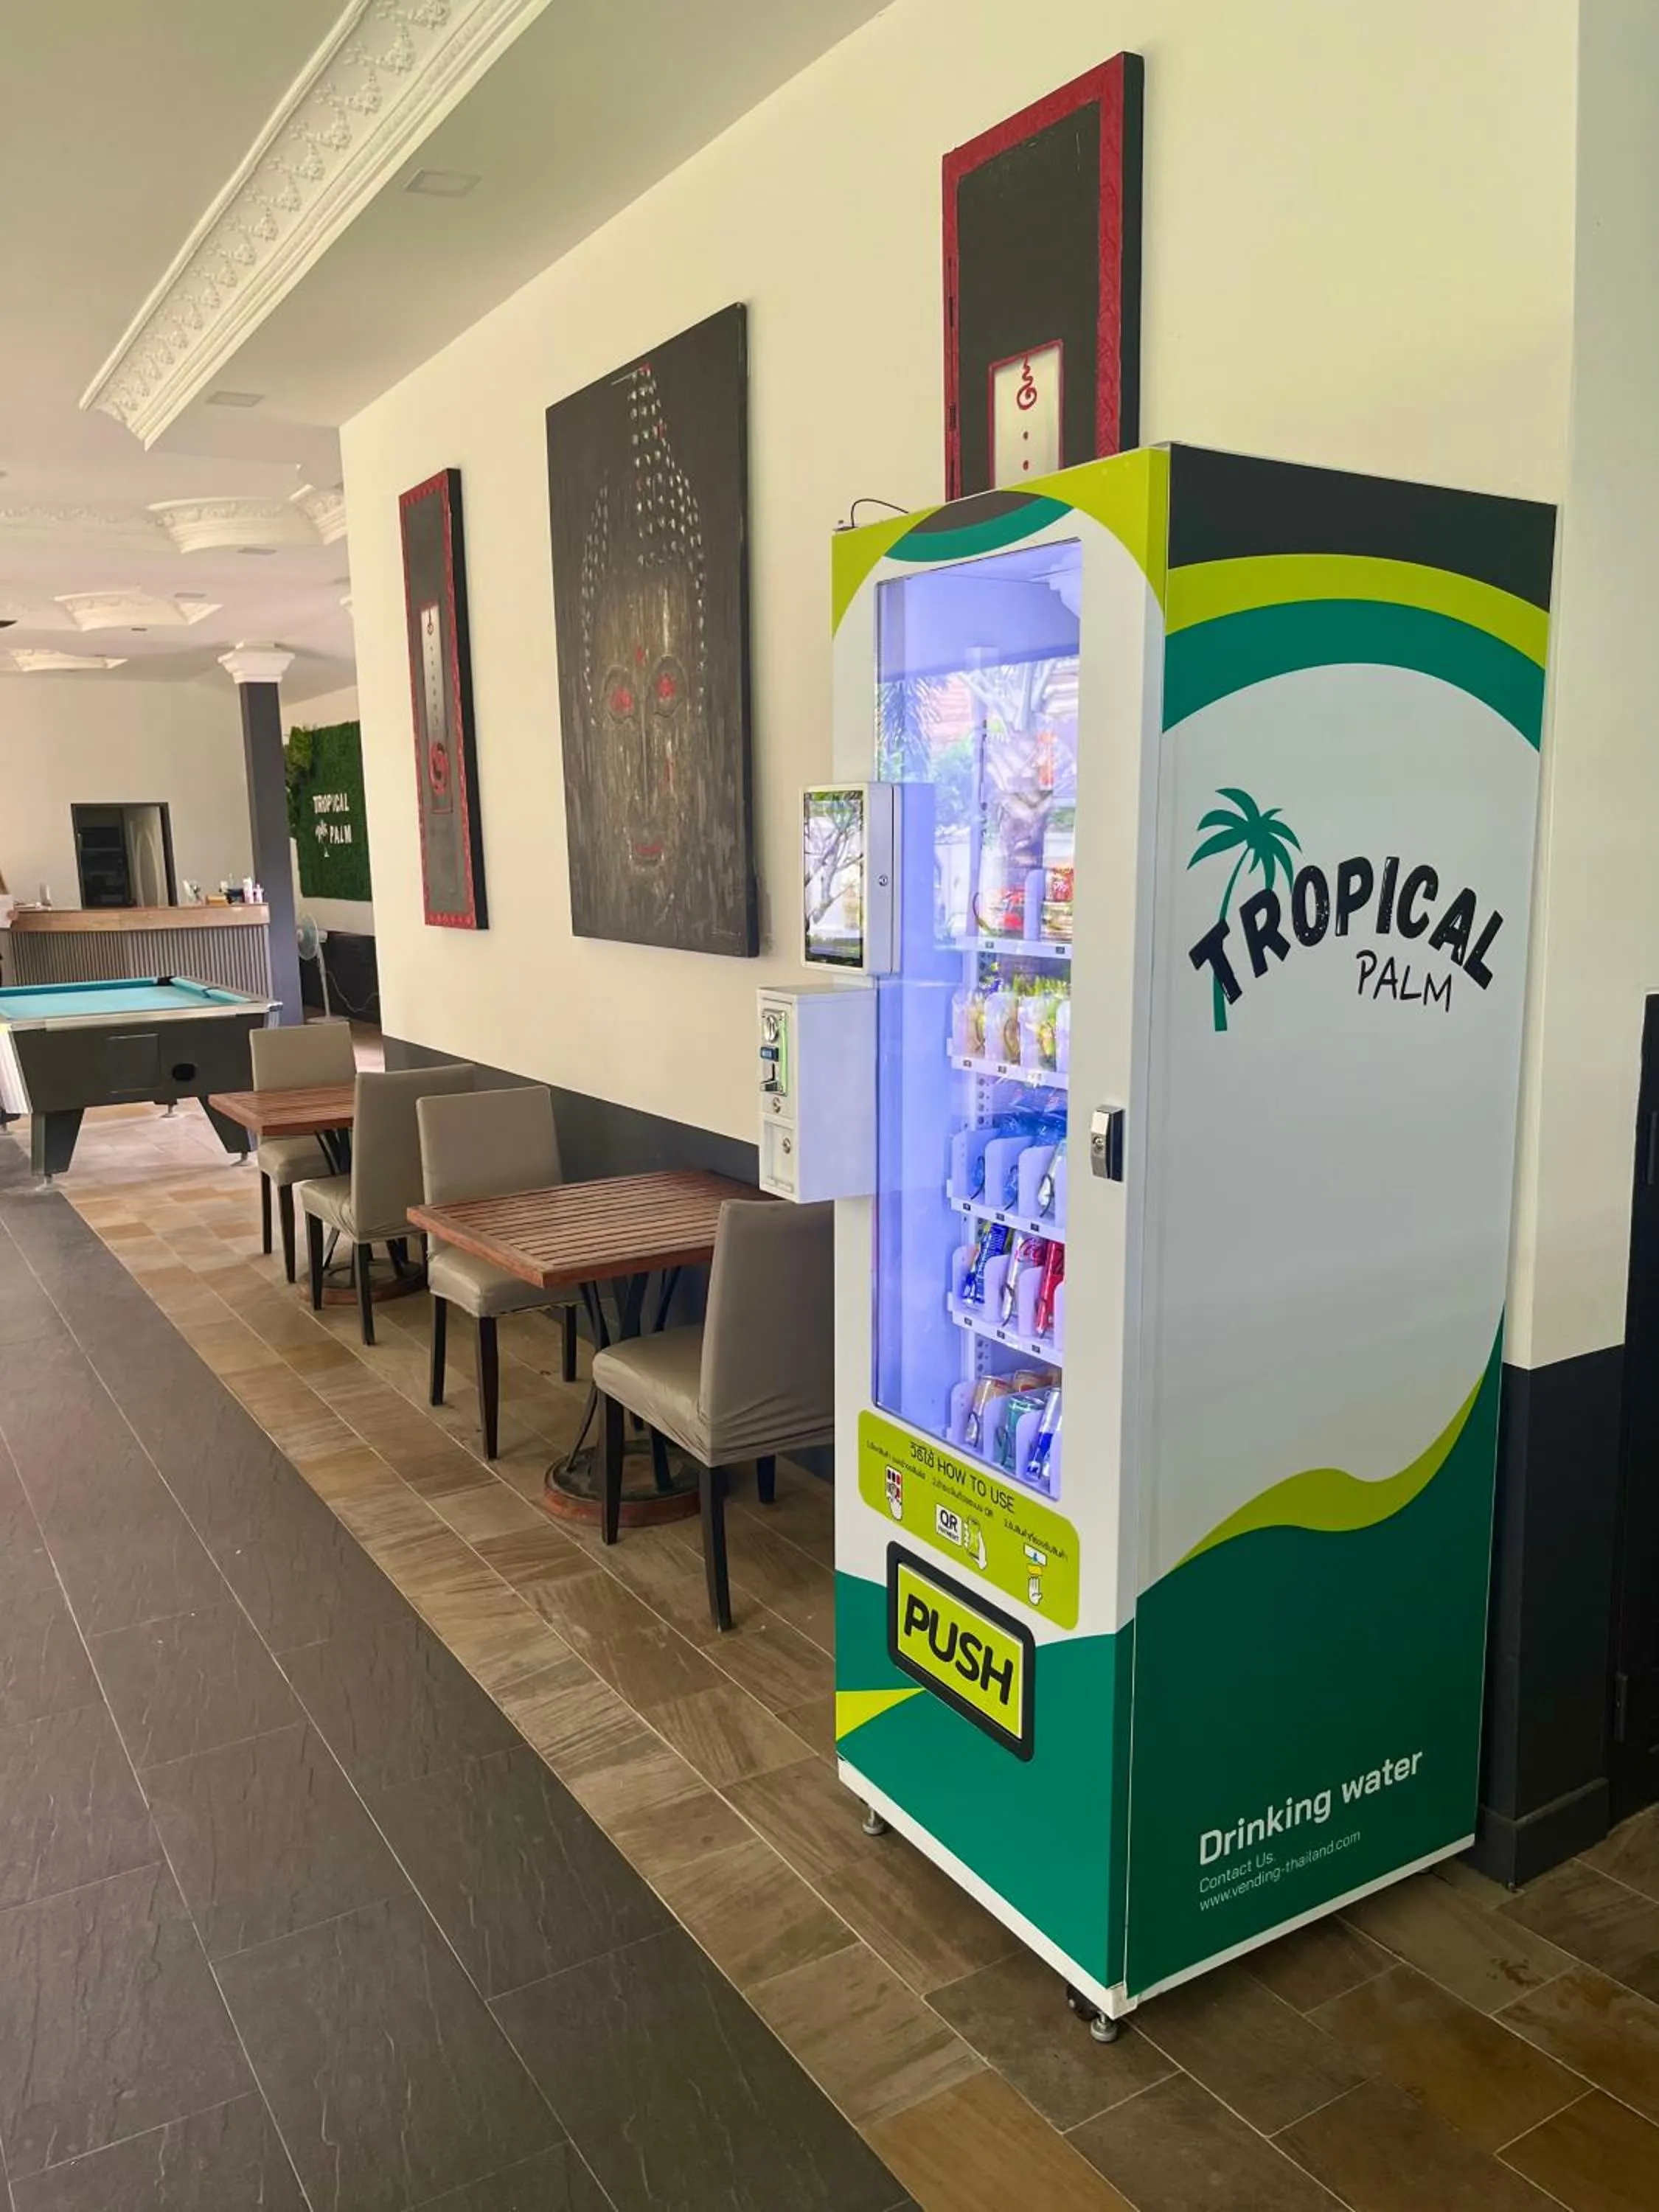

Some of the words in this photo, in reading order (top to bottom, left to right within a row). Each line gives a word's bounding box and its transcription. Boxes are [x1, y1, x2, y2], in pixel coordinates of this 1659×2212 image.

[312, 793, 350, 815] TROPICAL
[330, 824, 352, 844] PALM
[1188, 856, 1504, 1006] TROPICAL
[1356, 949, 1452, 1013] PALM
[937, 1457, 967, 1486] HOW
[970, 1474, 987, 1497] TO
[990, 1486, 1015, 1514] USE
[940, 1509, 958, 1533] QR
[904, 1593, 1014, 1705] PUSH
[1200, 1789, 1332, 1866] Drinking
[1341, 1750, 1423, 1804] water
[1199, 1831, 1361, 1912] www.vending-thailand.com
[1199, 1860, 1253, 1893] Contact
